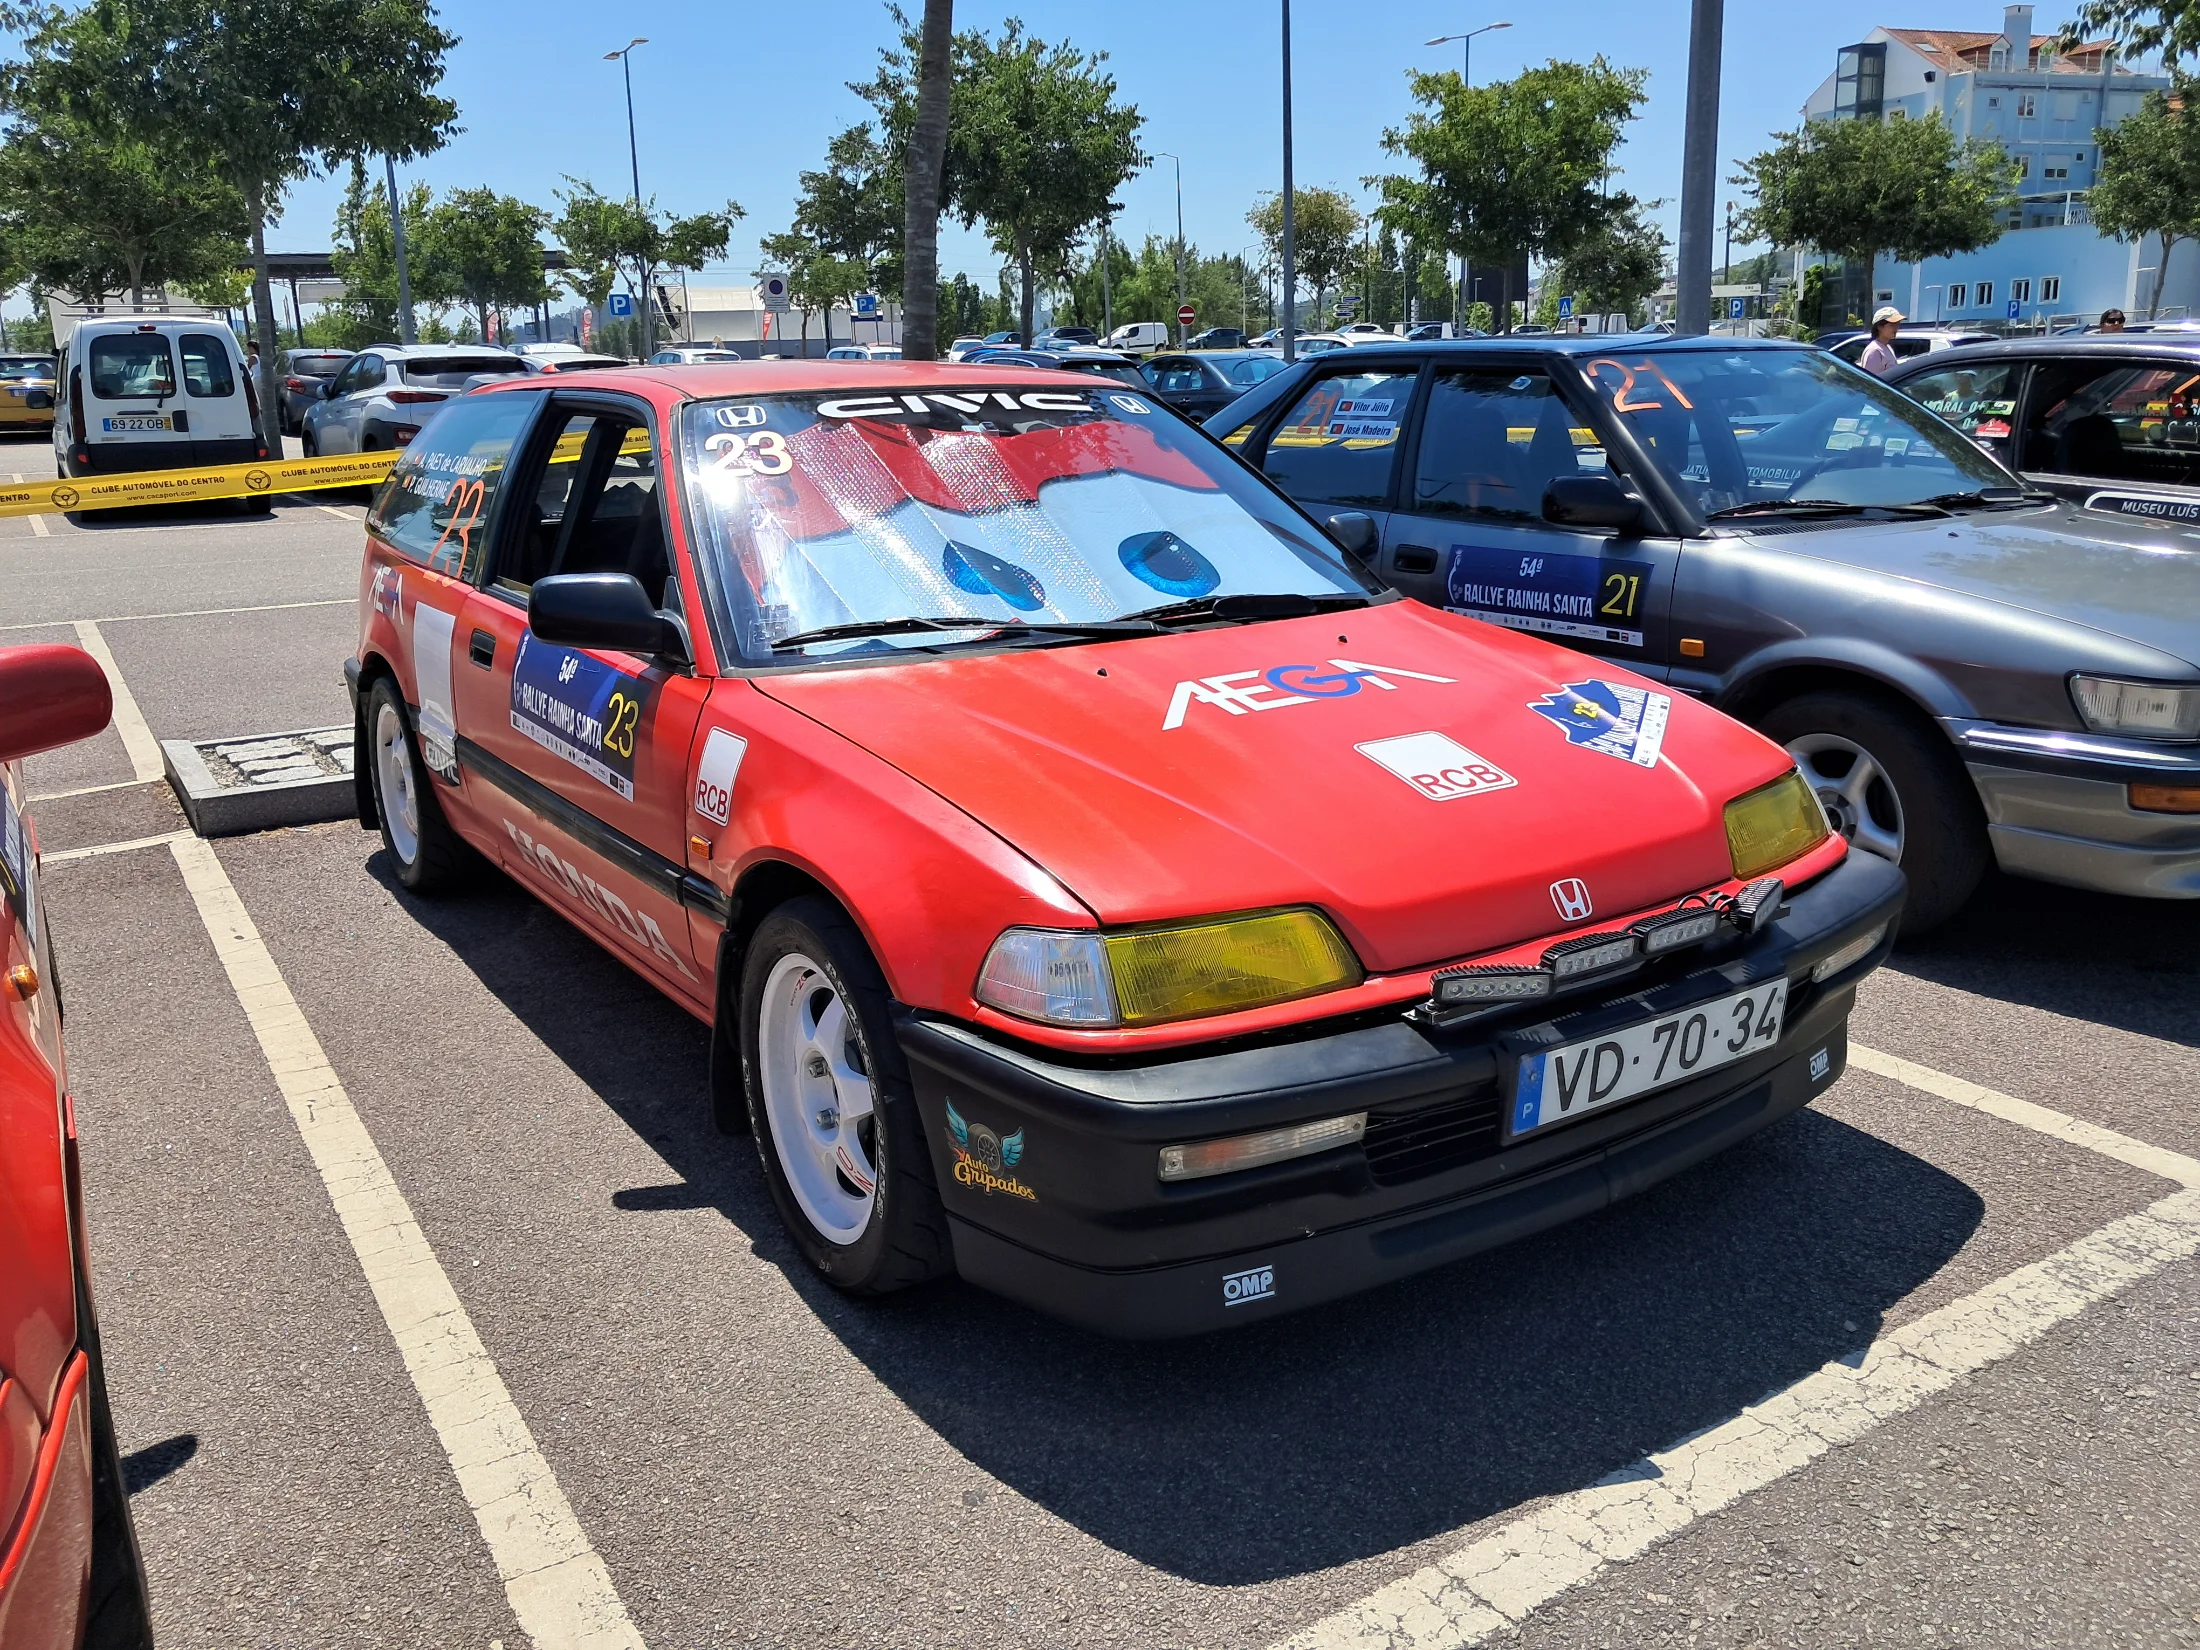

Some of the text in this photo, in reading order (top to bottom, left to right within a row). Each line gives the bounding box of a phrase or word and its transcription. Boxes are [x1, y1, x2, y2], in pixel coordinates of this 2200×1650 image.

[612, 296, 627, 314] P
[859, 298, 868, 311] P
[1732, 300, 1741, 316] P
[2009, 301, 2018, 317] P
[1586, 358, 1694, 413] 21
[816, 392, 1094, 418] CIVIC
[1352, 401, 1390, 412] Vitor Júlio
[1343, 424, 1392, 436] José Madeira
[704, 430, 794, 477] 23
[281, 469, 308, 478] CLUBE
[310, 464, 358, 475] AUTOMÓVEL
[371, 460, 397, 469] CENTR
[449, 455, 488, 477] CARVALHO
[91, 476, 225, 494] CLUBE AUTOMÓVEL DO CENTRO
[413, 476, 451, 499] GUILHERME
[0, 493, 31, 503] ENTRO
[2121, 501, 2199, 518] MUSEU LUÍS
[423, 478, 486, 587] 23
[1464, 583, 1593, 618] RALLYE RAINHA SANTA
[1601, 573, 1639, 617] 21
[522, 683, 602, 751] RALLYE RAINHA SANTA
[603, 692, 640, 758] 23
[1410, 763, 1504, 797] RCB
[697, 780, 728, 817] RCB
[502, 817, 701, 984] HONDA
[1809, 1051, 1829, 1076] OMP
[1521, 1101, 1534, 1120] P
[964, 1153, 989, 1173] Auto
[954, 1161, 1036, 1200] Gripados
[1222, 1269, 1275, 1299] OMP
